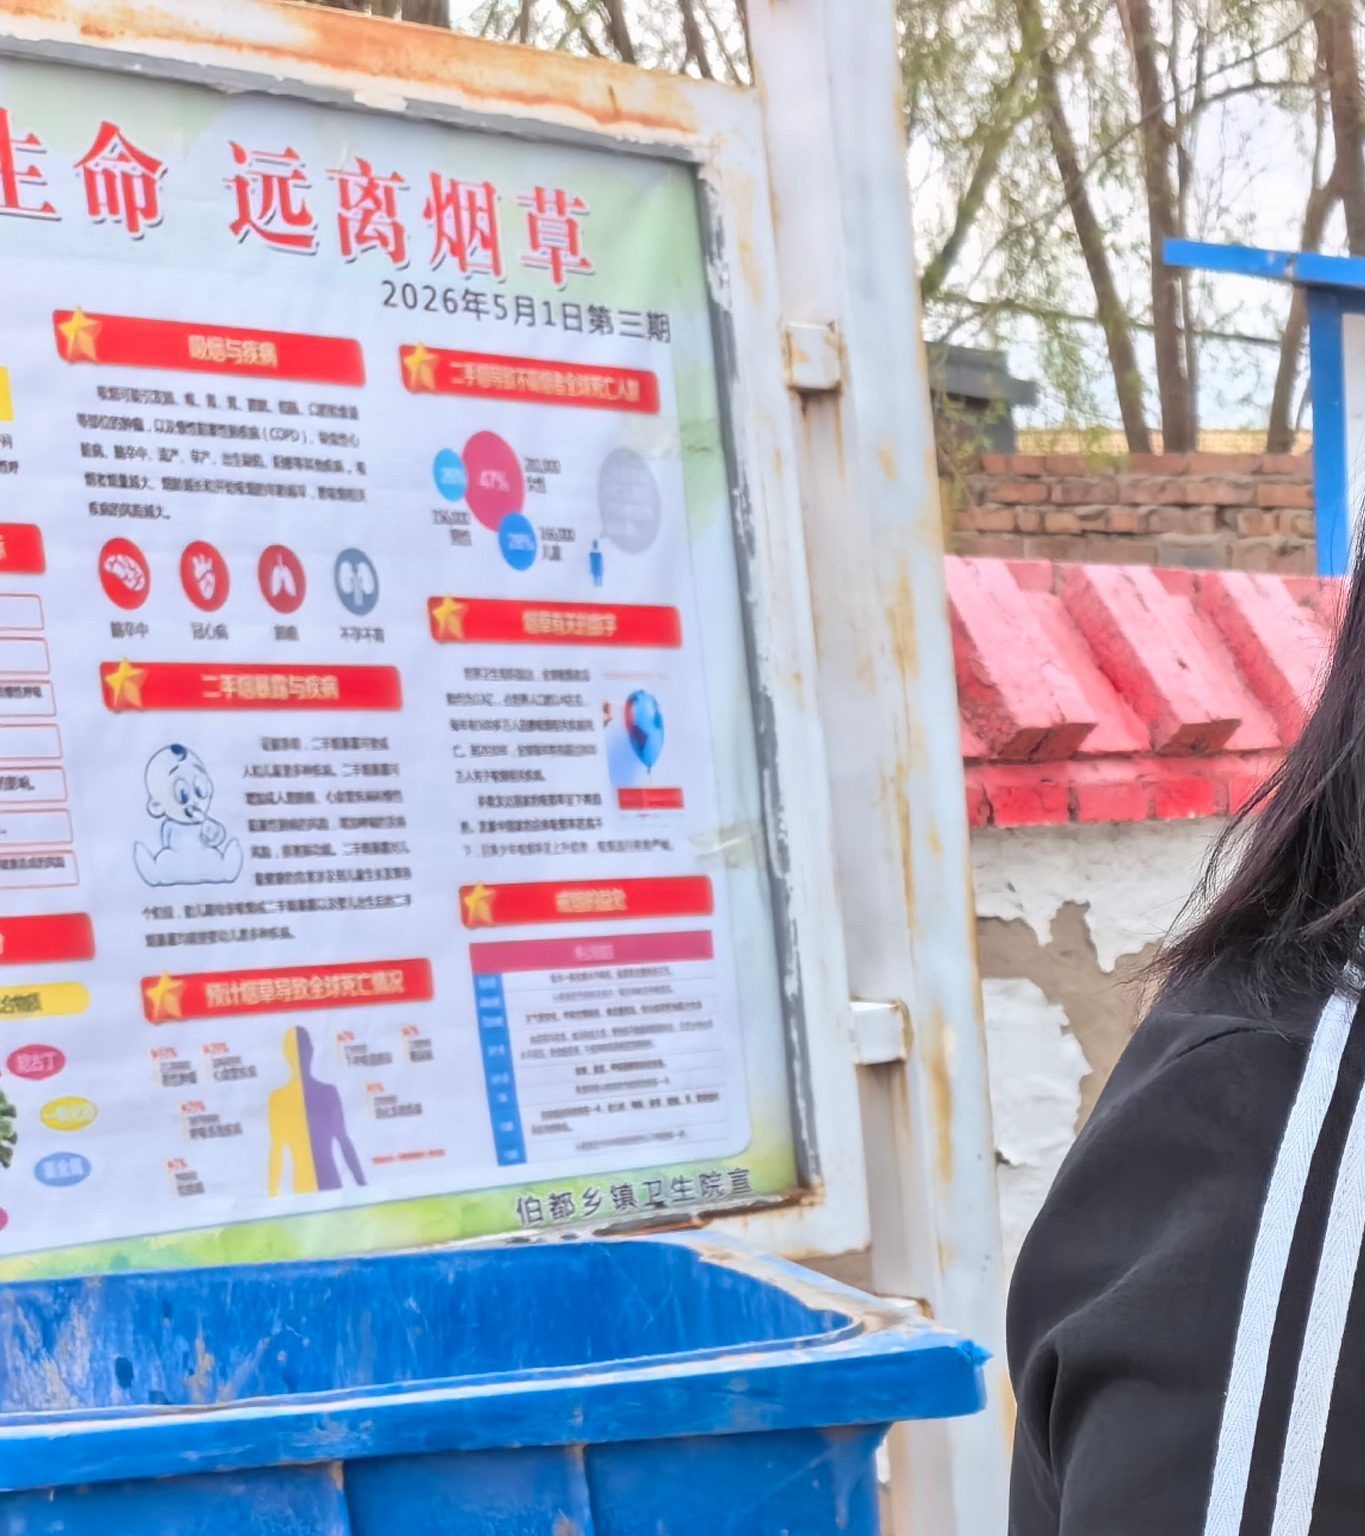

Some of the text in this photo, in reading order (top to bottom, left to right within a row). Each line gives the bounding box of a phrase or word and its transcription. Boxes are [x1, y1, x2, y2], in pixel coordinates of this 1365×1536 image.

[225, 141, 595, 288] 远离烟草
[382, 281, 671, 343] 2026年5月1日第三期
[516, 1167, 753, 1227] 伯都乡镇卫生院宣
